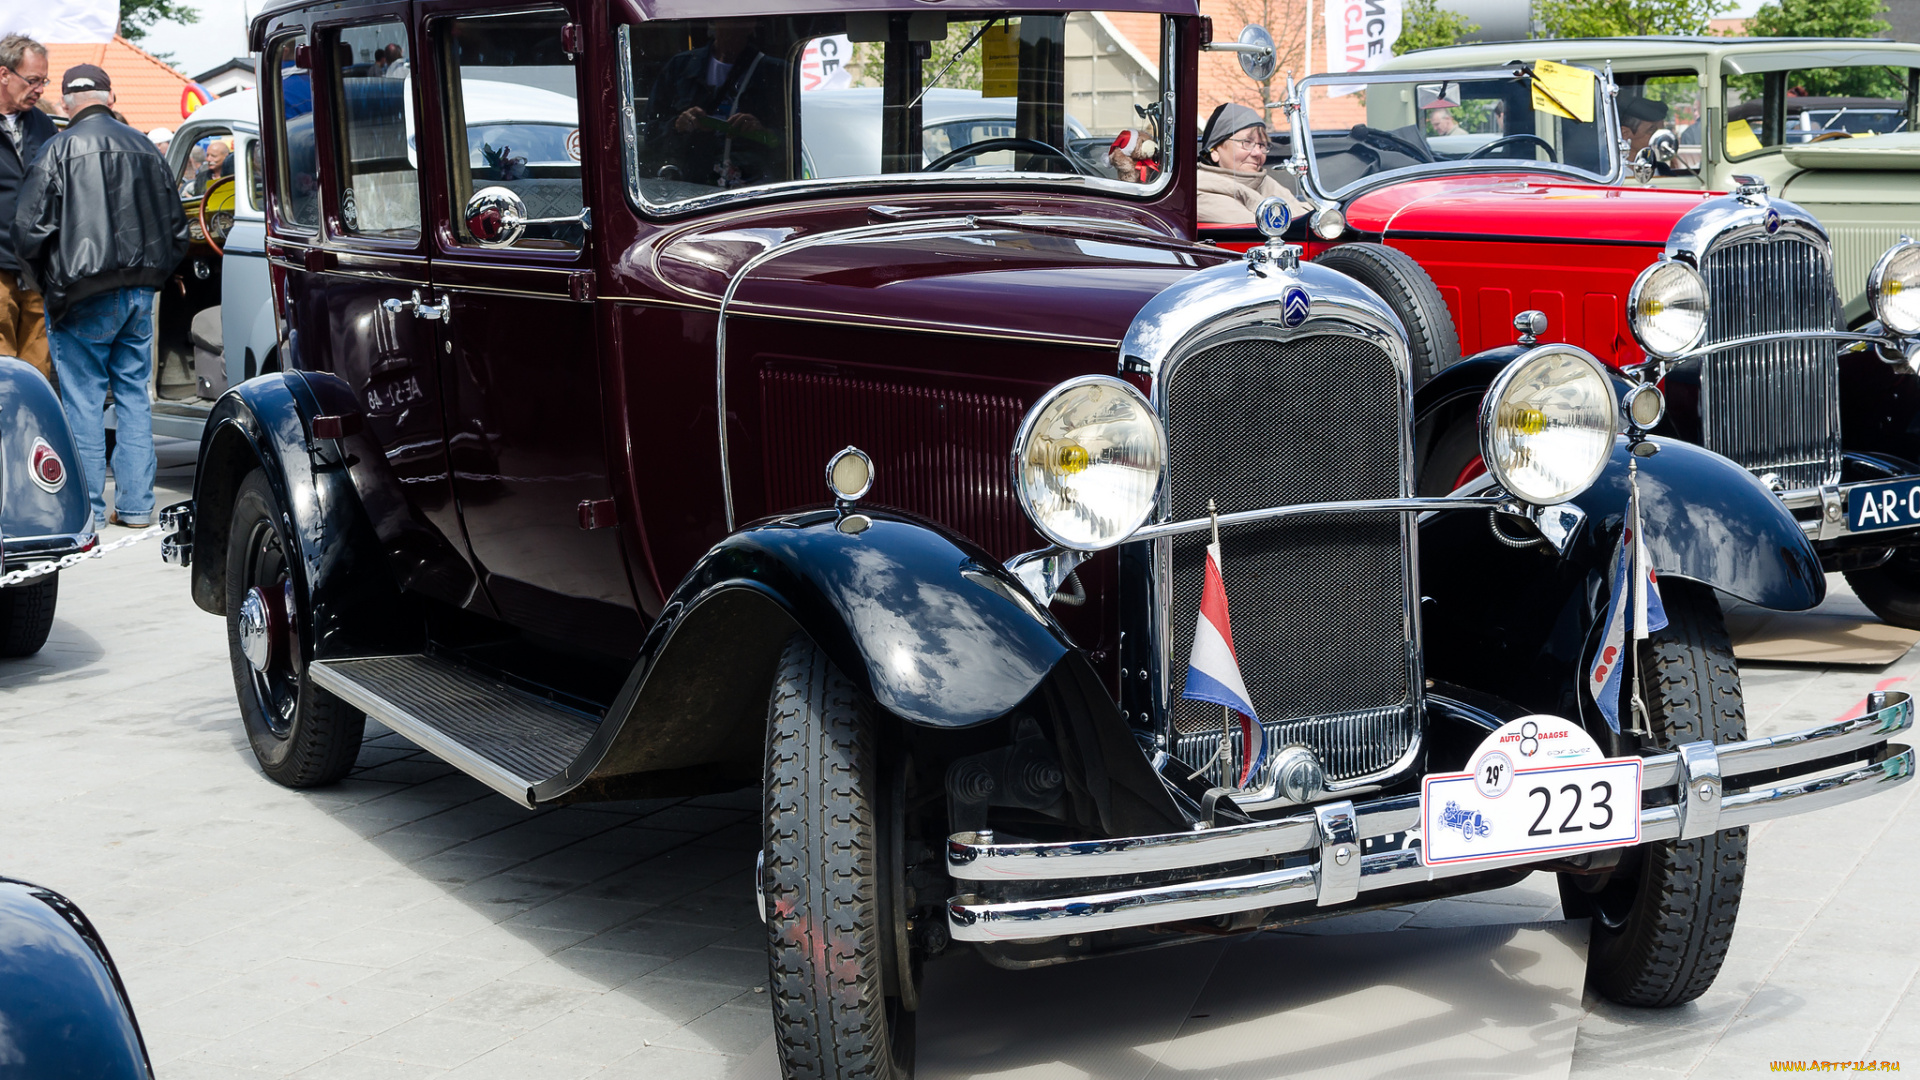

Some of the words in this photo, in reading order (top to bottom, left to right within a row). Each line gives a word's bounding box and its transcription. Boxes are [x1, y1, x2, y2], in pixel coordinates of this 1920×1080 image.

[1499, 734, 1521, 744] AUTO
[1519, 721, 1539, 757] 8
[1537, 730, 1569, 740] DAAGSE
[1528, 780, 1614, 837] 223
